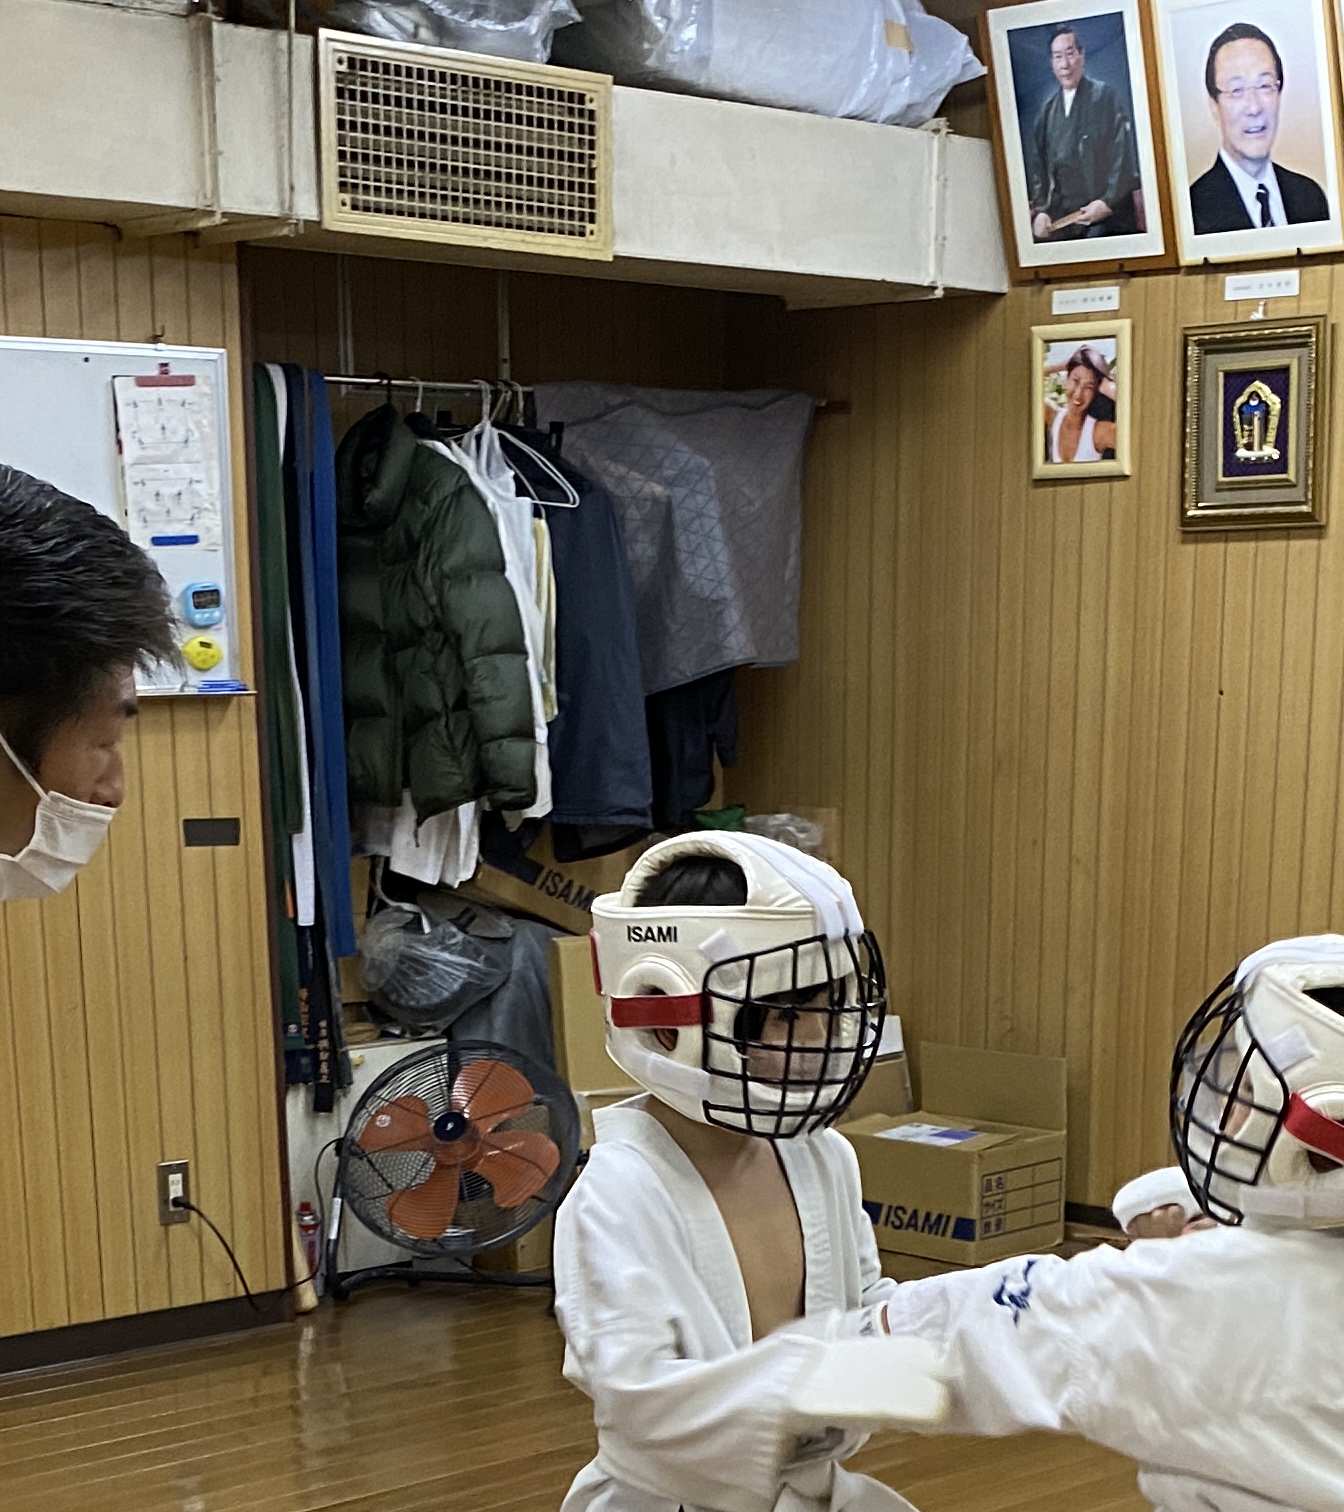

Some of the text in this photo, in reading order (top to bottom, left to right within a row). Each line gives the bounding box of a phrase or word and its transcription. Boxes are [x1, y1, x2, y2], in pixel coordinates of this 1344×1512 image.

[537, 868, 597, 912] ISAM
[626, 924, 678, 944] ISAMI
[882, 1204, 952, 1238] ISAMI
